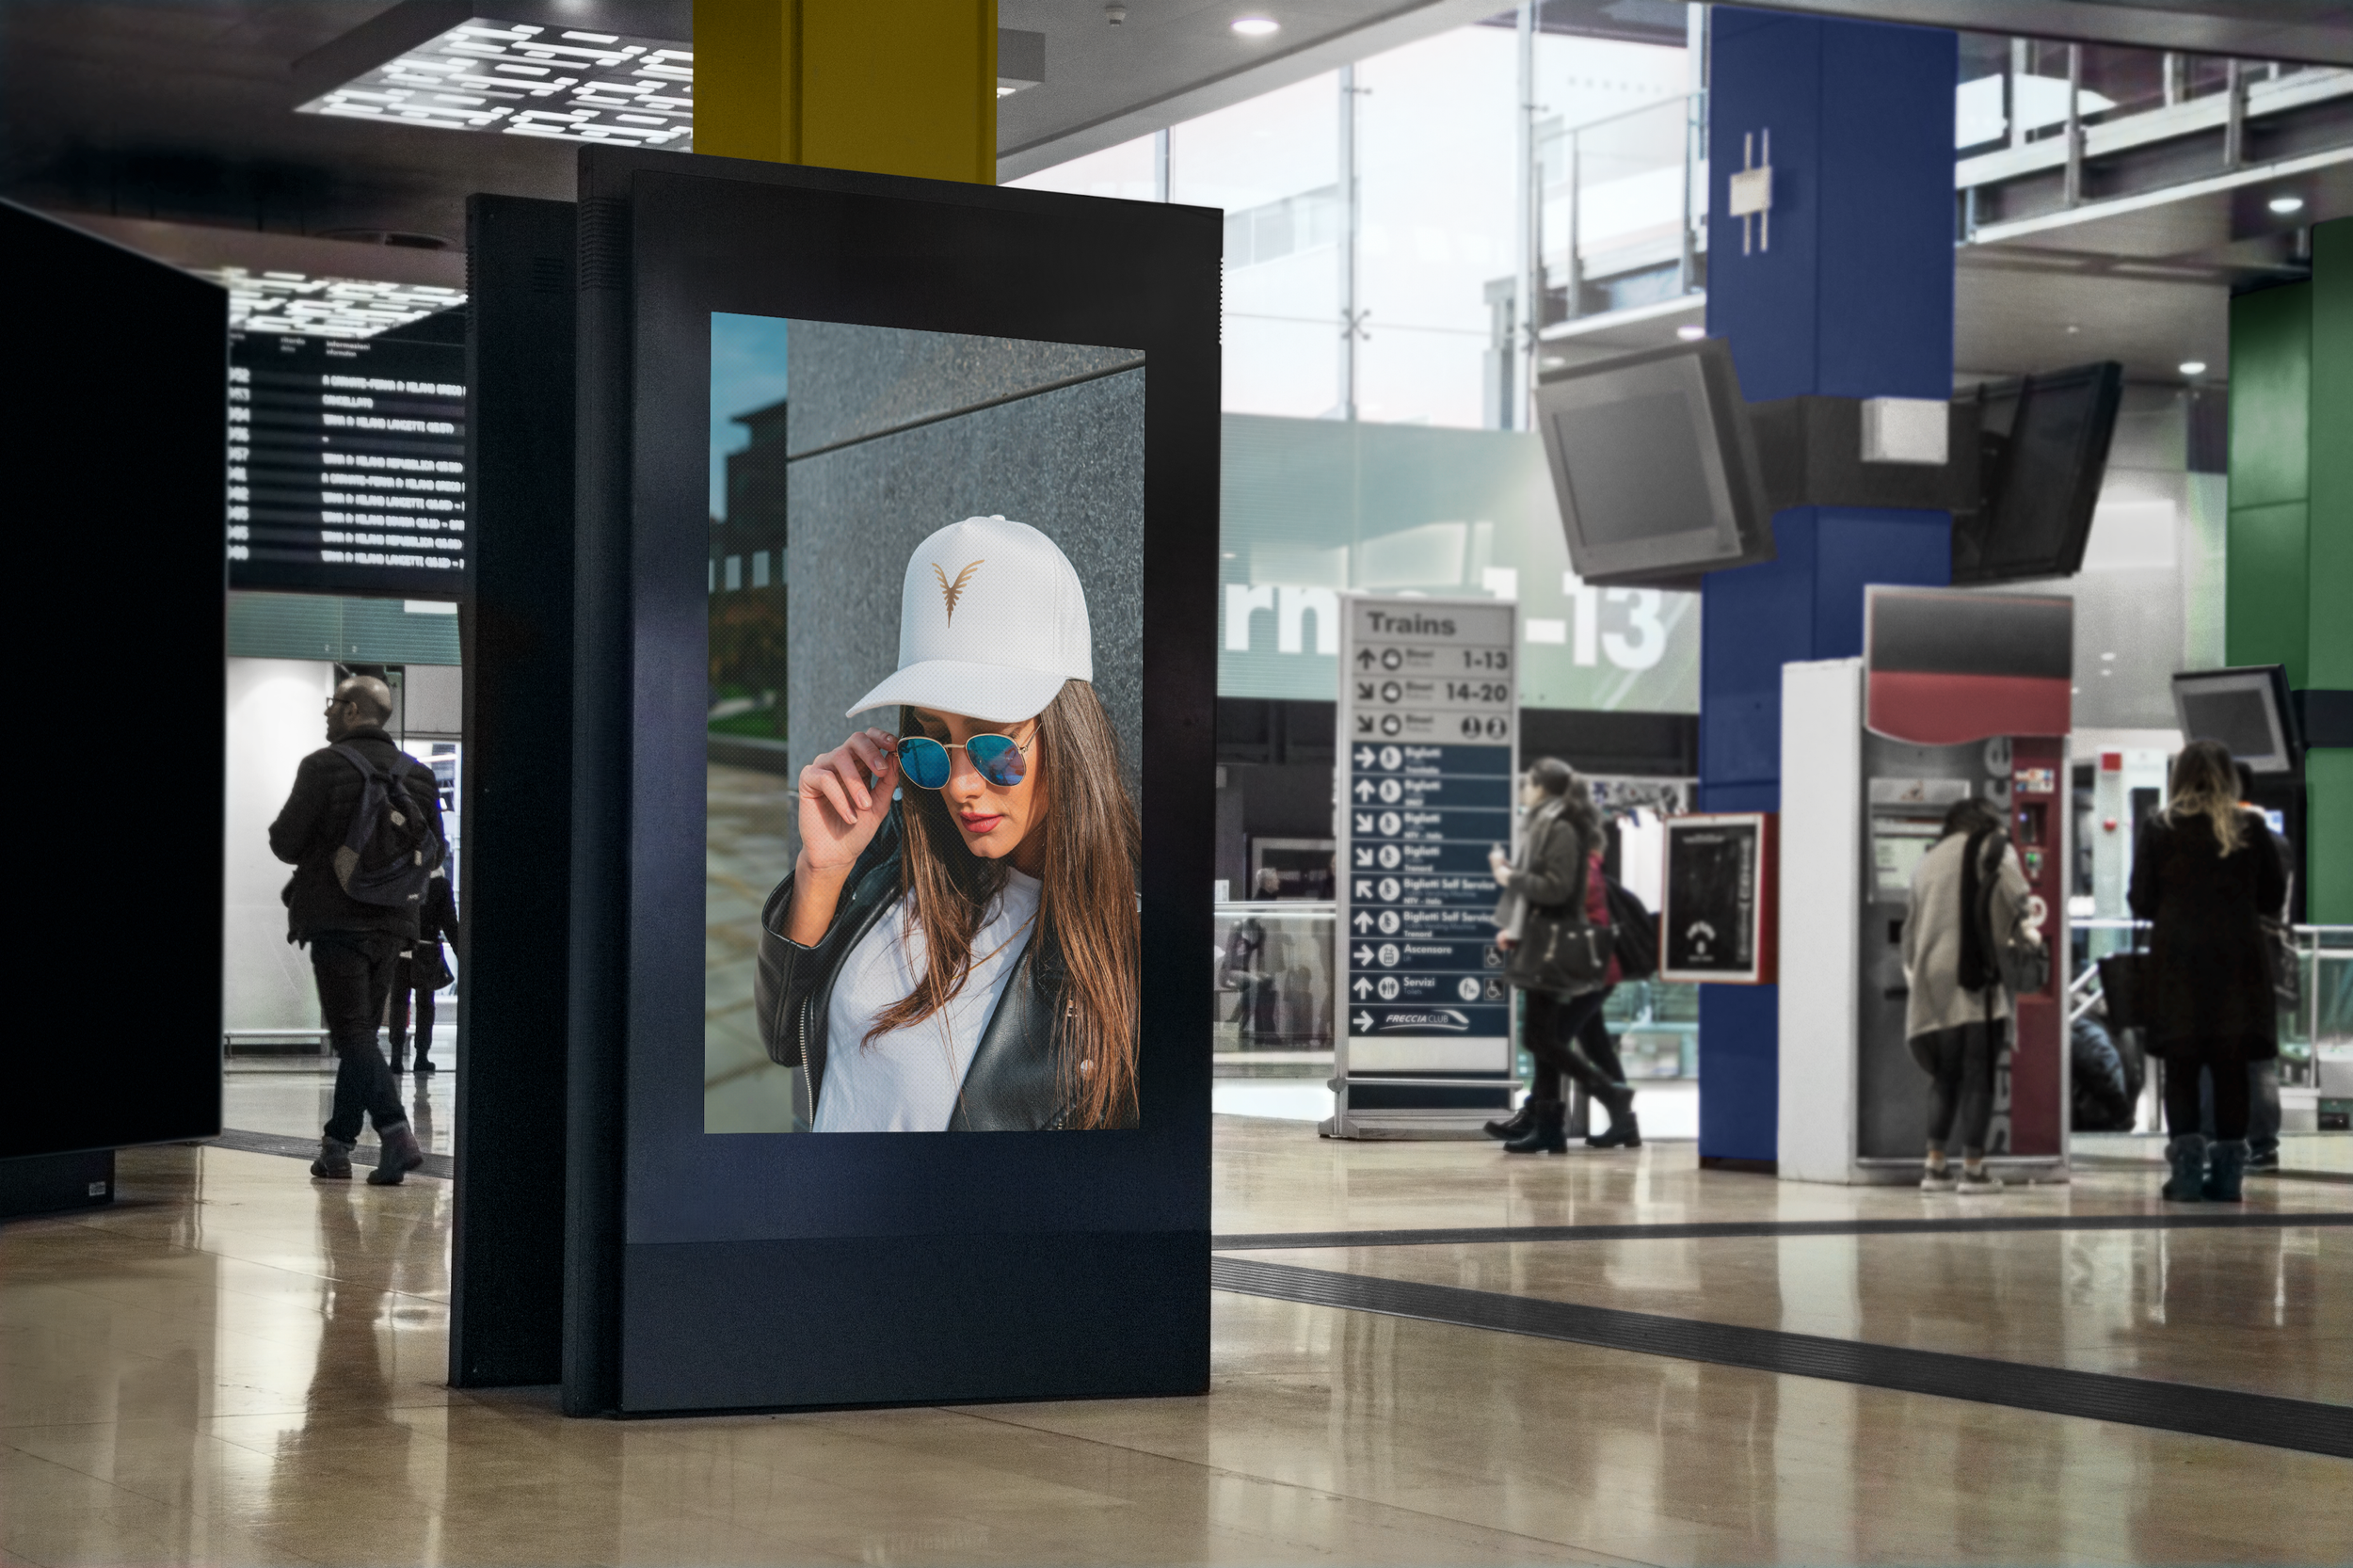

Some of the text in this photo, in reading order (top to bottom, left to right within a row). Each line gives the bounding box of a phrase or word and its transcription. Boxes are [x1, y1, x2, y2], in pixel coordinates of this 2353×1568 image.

[1368, 612, 1456, 636] Trains
[1464, 650, 1508, 670] 1-13
[1447, 682, 1508, 702] 14-20
[1404, 746, 1441, 760] Biglietti
[1404, 779, 1441, 792] Biglietti
[1404, 812, 1441, 824] Biglietti
[1404, 845, 1440, 857] Biglietti
[1403, 878, 1497, 889] Biglietti Self Service
[1403, 911, 1439, 922] Biglietti
[1442, 912, 1460, 921] Self
[1403, 944, 1452, 954] Ascensore
[1403, 977, 1435, 987] Servizi
[1385, 1015, 1449, 1023] FRECCIA CLUB
